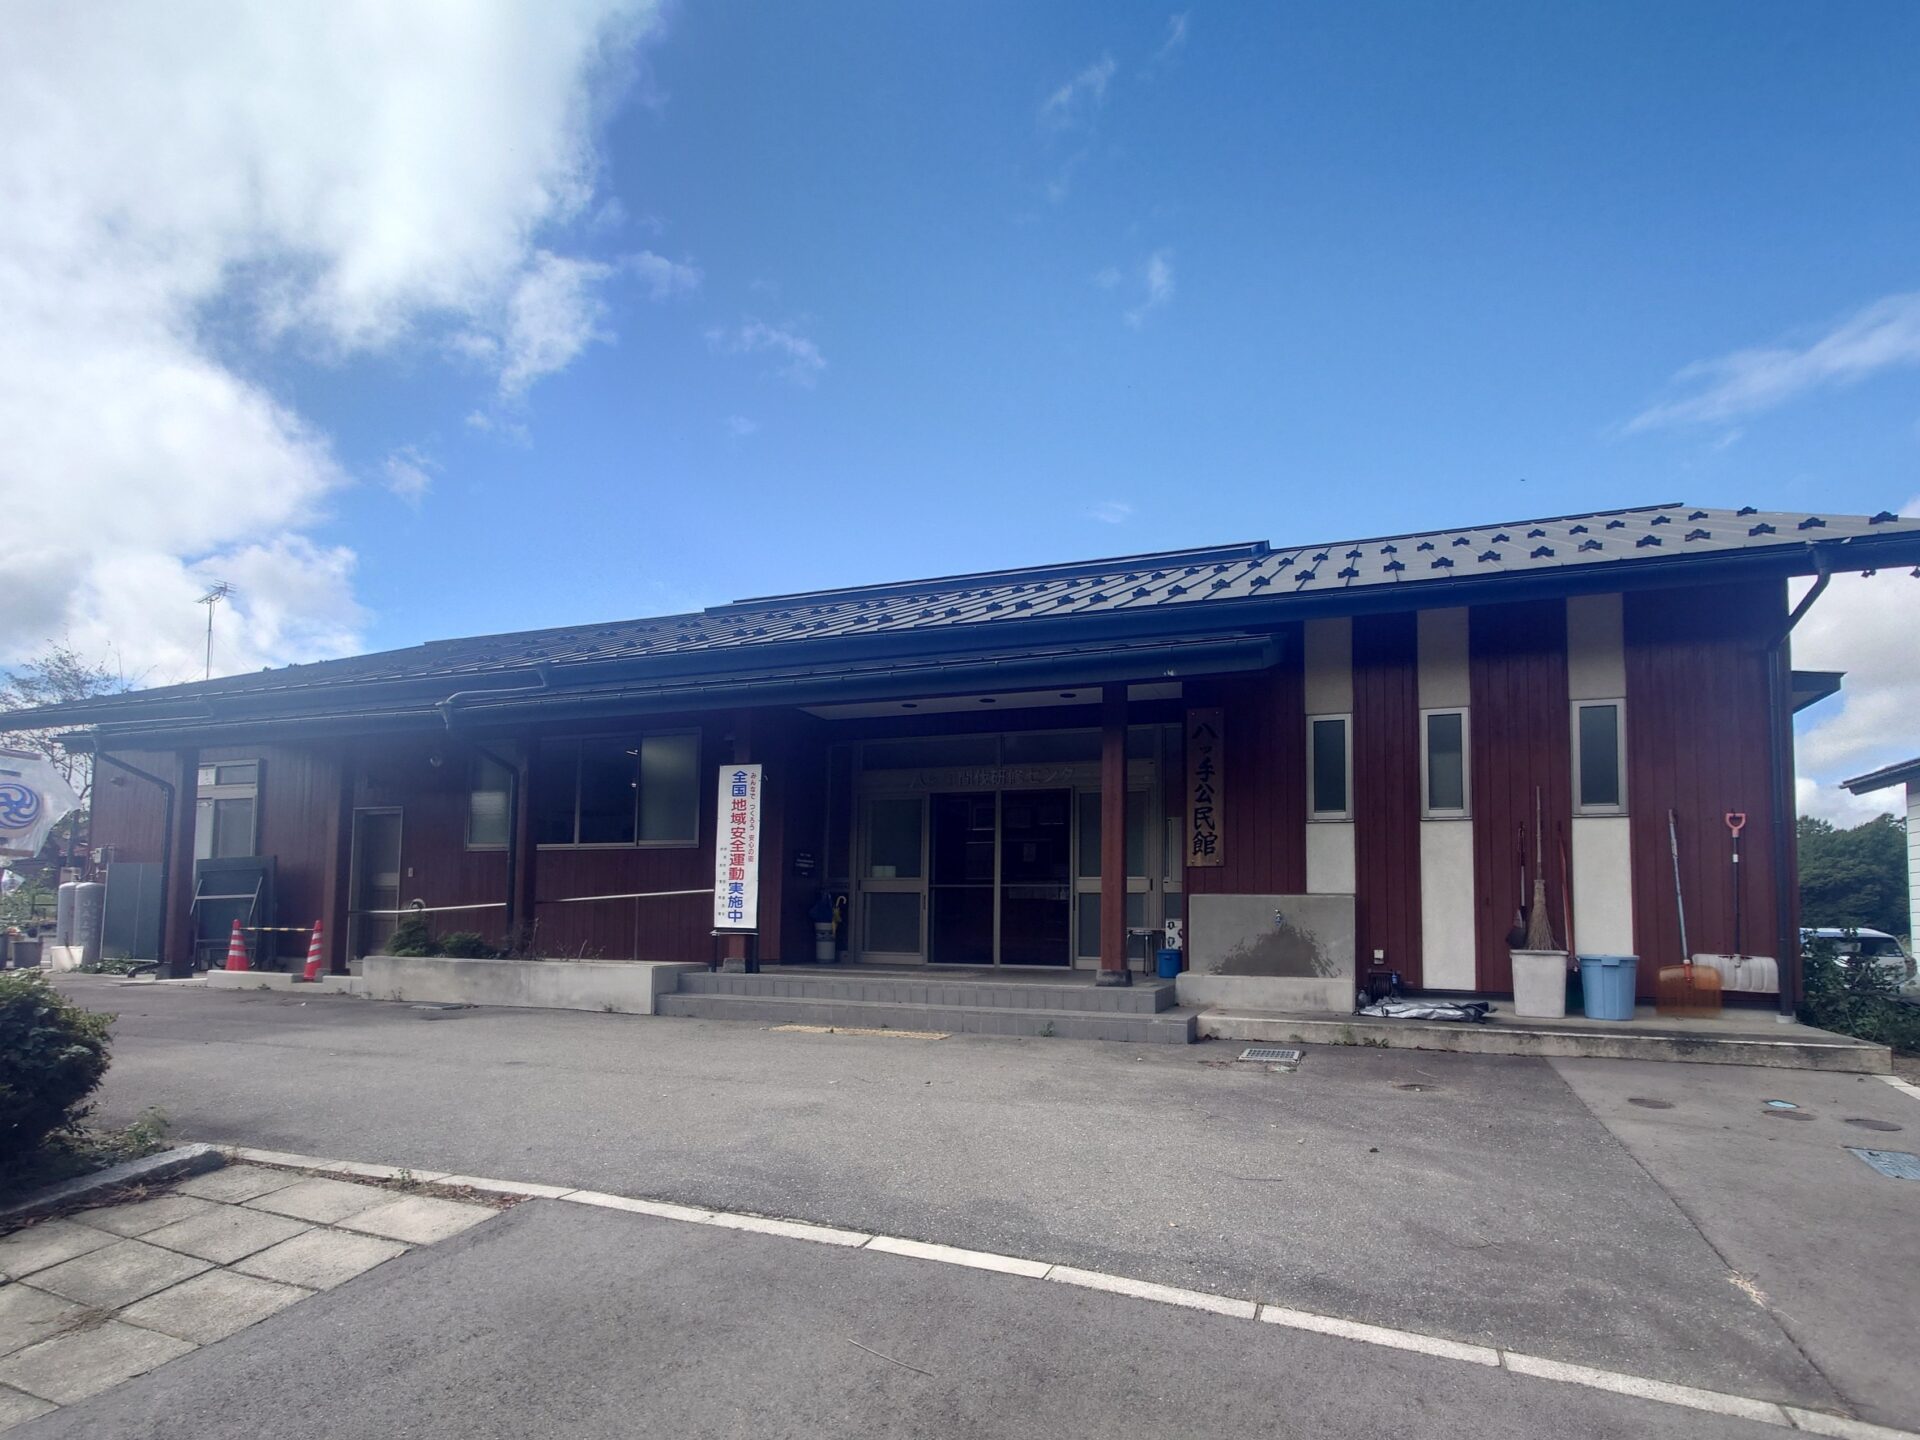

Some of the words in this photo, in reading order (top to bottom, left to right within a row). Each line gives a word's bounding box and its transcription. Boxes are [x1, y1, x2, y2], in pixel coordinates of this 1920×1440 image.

[727, 770, 748, 923] 全国地域安全運動実施中
[1191, 722, 1219, 857] 八ッ手公民館
